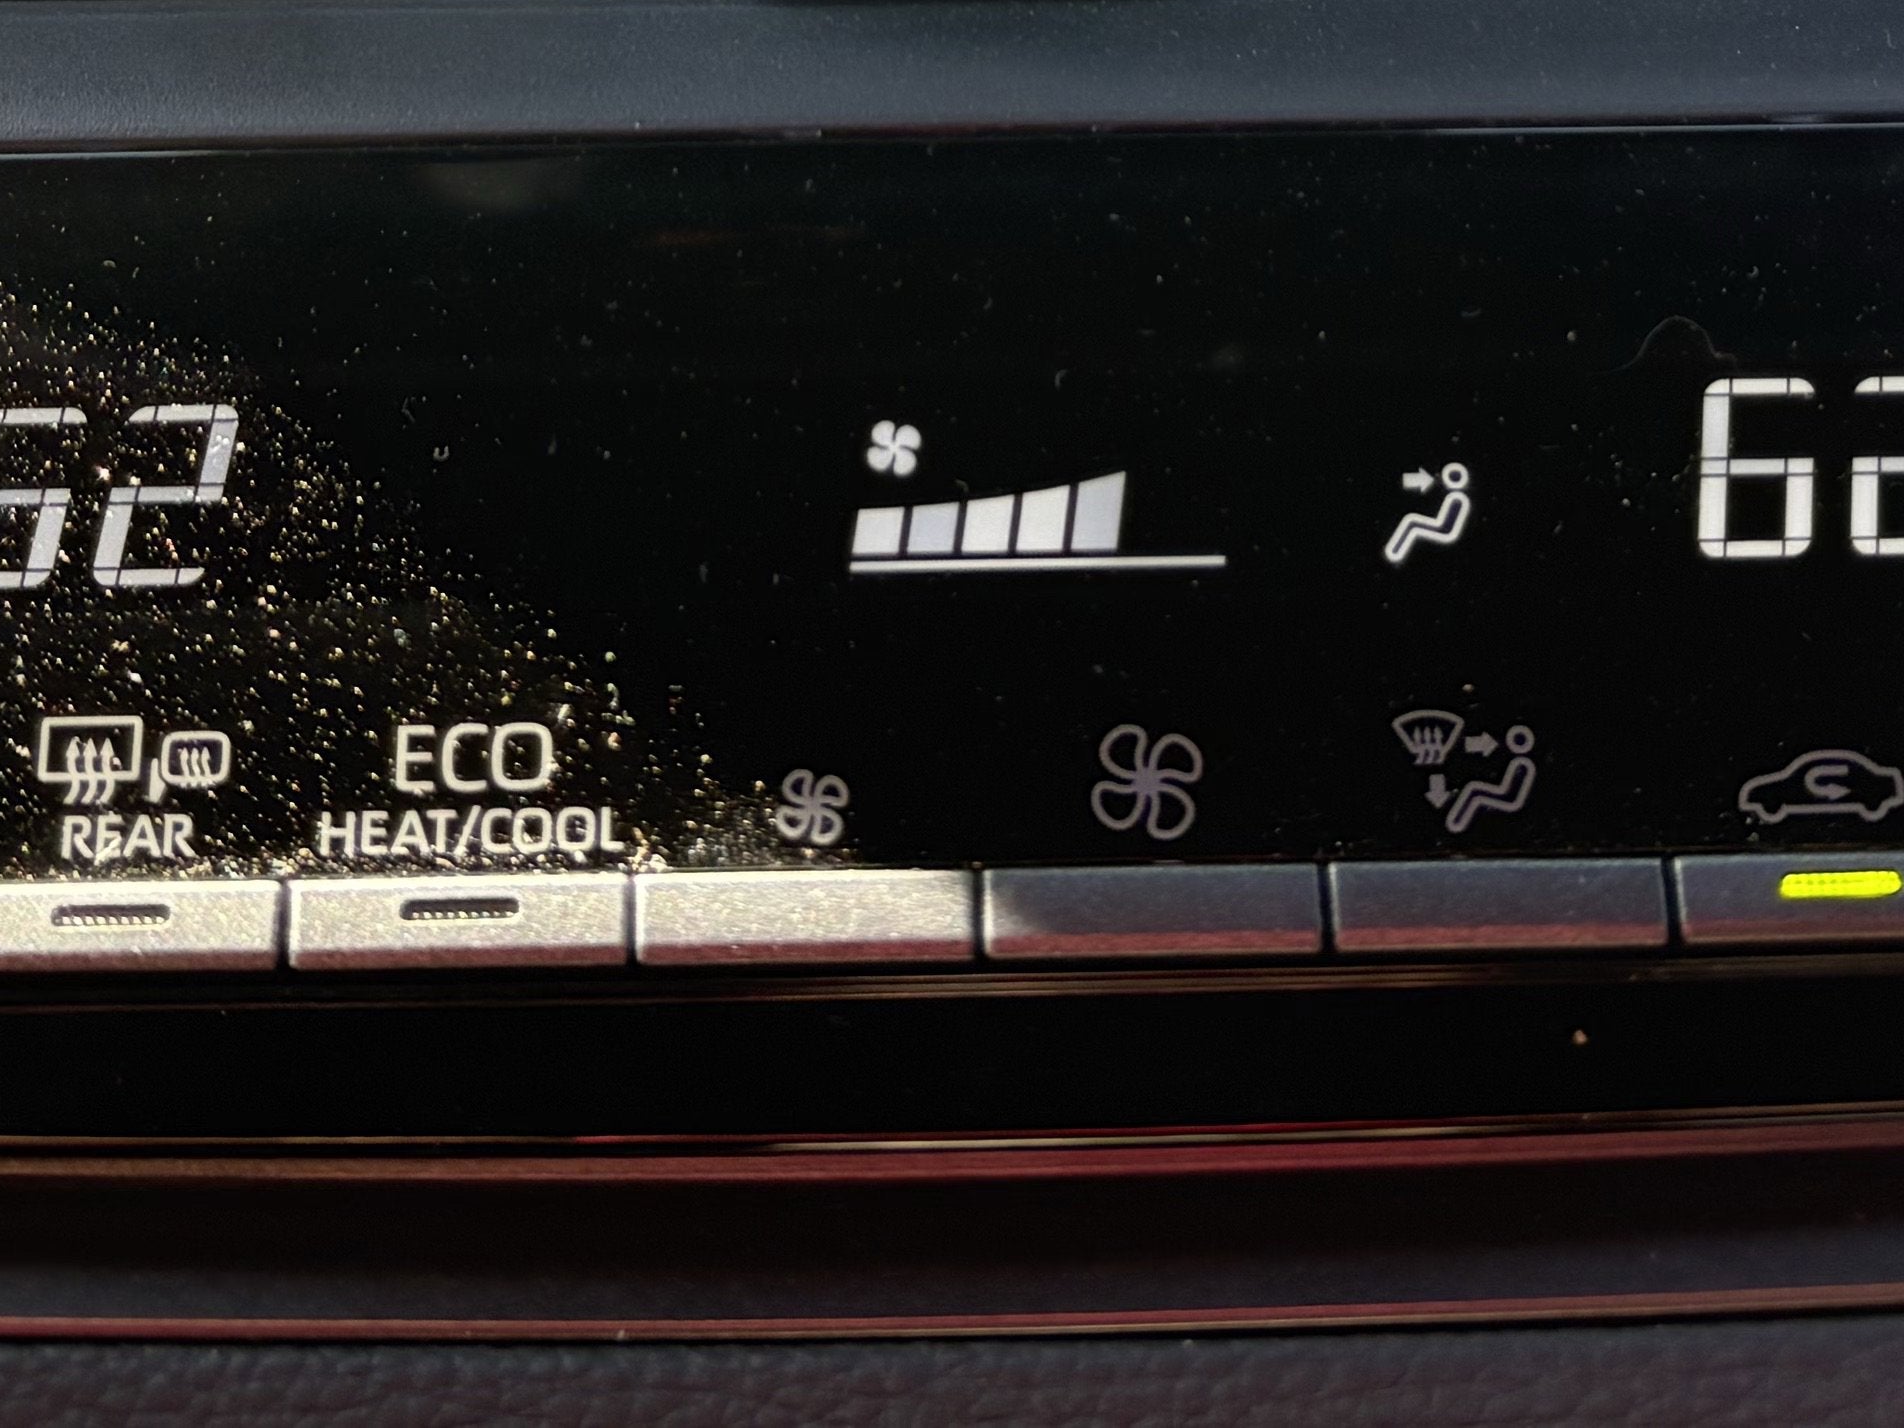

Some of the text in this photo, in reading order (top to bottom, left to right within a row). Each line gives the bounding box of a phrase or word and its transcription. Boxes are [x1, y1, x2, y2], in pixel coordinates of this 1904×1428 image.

[394, 723, 554, 793] ECO
[61, 813, 196, 860] REAR
[318, 806, 626, 858] HEAT/COOL
